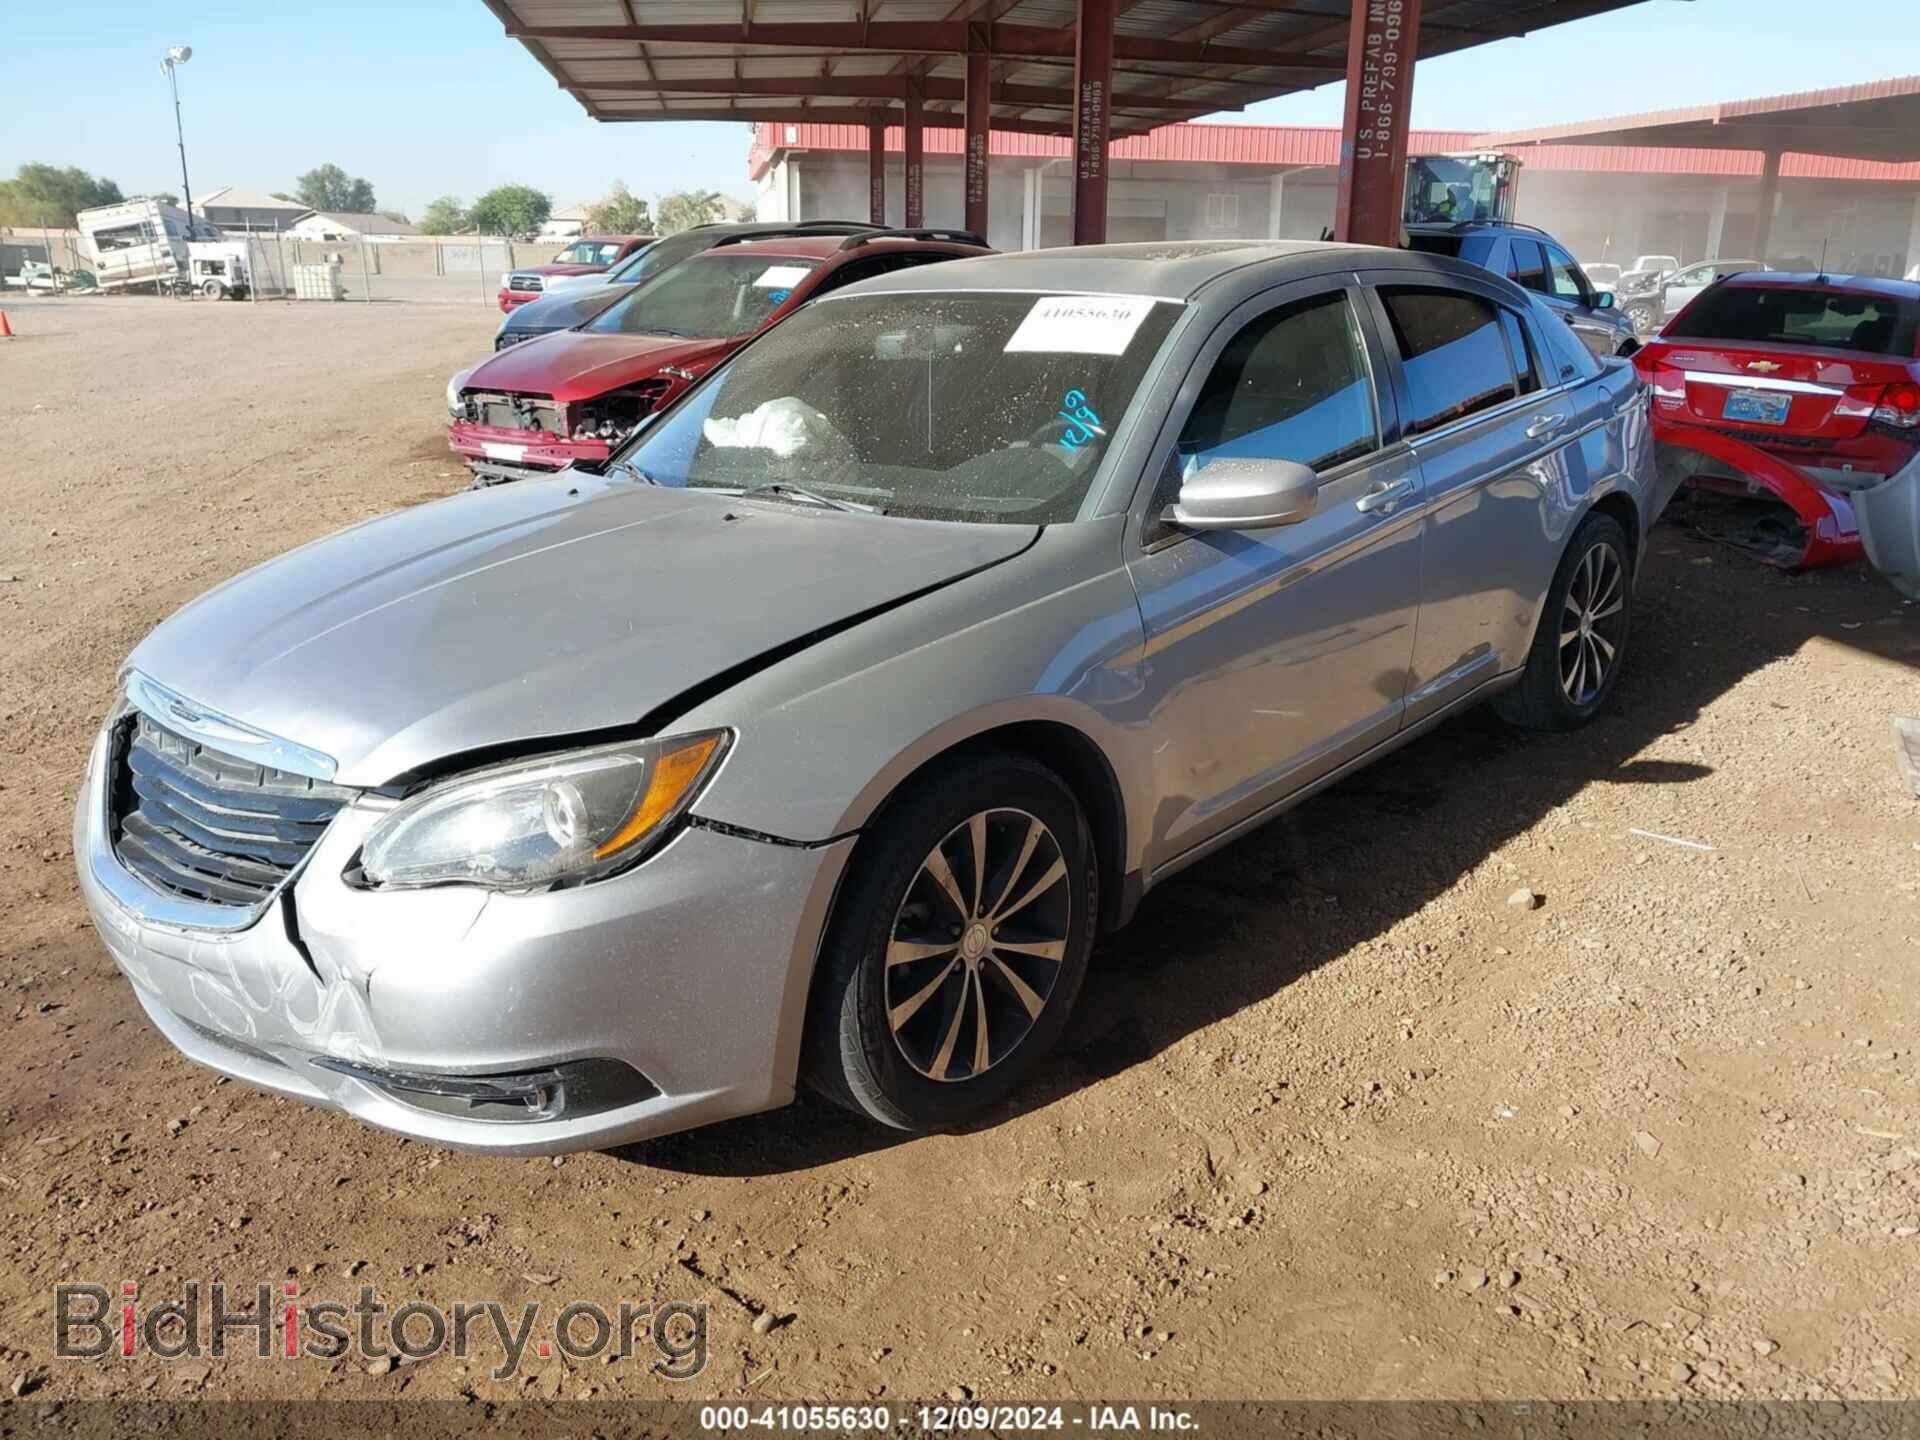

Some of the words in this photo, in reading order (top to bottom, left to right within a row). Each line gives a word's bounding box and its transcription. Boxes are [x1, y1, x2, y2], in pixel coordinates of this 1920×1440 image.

[1369, 0, 1386, 22] IN
[1361, 33, 1383, 111] PREFAB
[1357, 123, 1374, 159] U.S.
